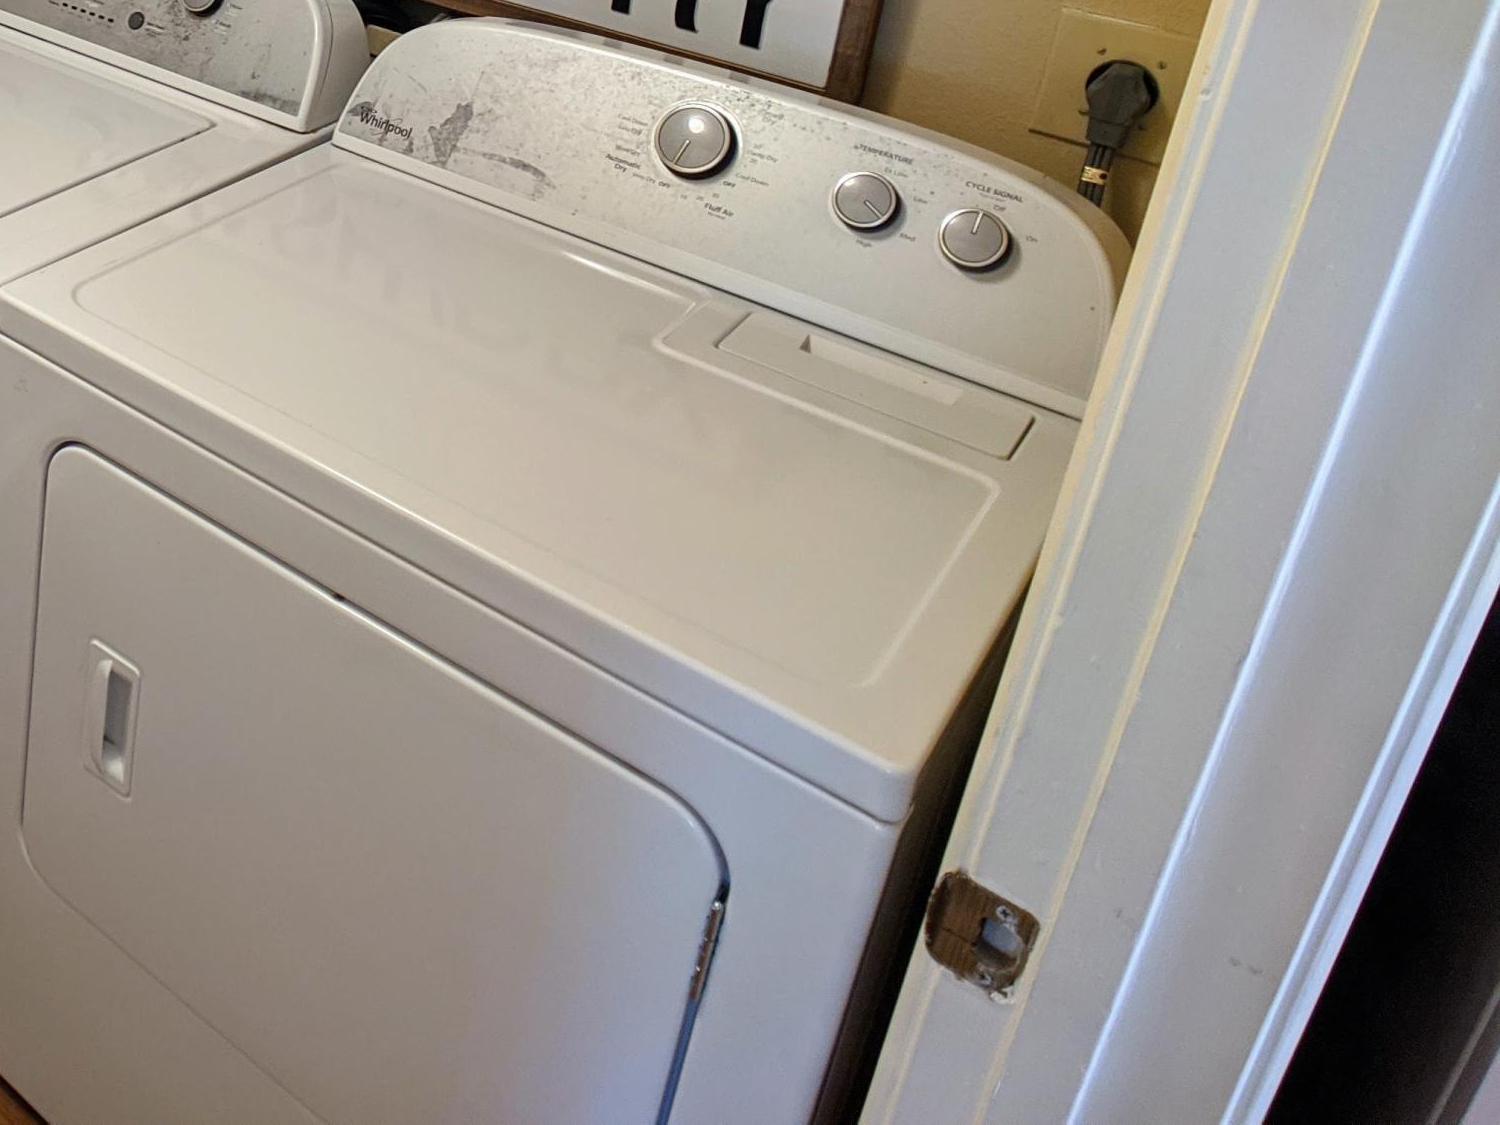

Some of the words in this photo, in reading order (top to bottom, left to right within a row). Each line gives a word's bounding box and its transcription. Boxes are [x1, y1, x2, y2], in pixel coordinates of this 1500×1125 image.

[360, 110, 413, 140] Whirlpool
[605, 153, 641, 170] Automatic
[859, 143, 914, 166] TEMPERATURE
[965, 180, 992, 194] CYCLE
[993, 188, 1024, 204] SIGNAL
